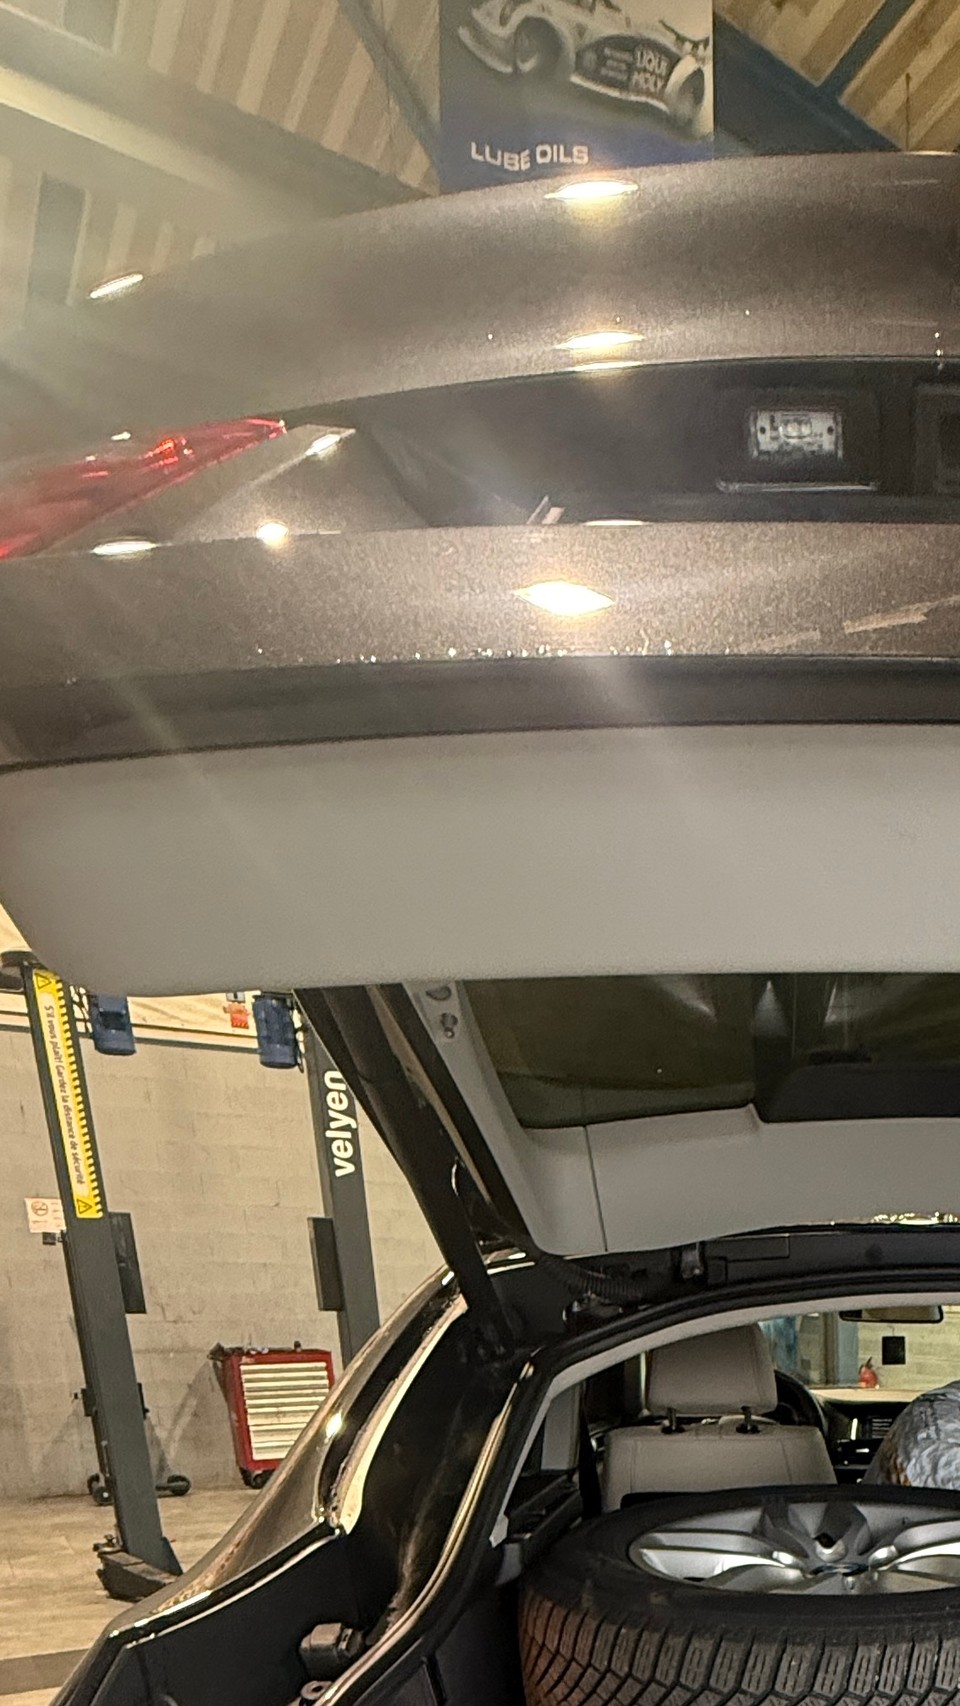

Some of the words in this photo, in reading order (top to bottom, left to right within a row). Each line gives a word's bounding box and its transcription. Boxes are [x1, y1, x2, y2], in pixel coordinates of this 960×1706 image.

[471, 141, 530, 171] LUBE
[535, 143, 589, 165] OILS
[48, 1019, 57, 1040] vous
[55, 1064, 67, 1093] Gardez
[61, 1095, 70, 1103] la
[63, 1104, 76, 1139] distance
[324, 1070, 357, 1177] velyen
[70, 1140, 79, 1151] de
[72, 1153, 86, 1185] sécurité
